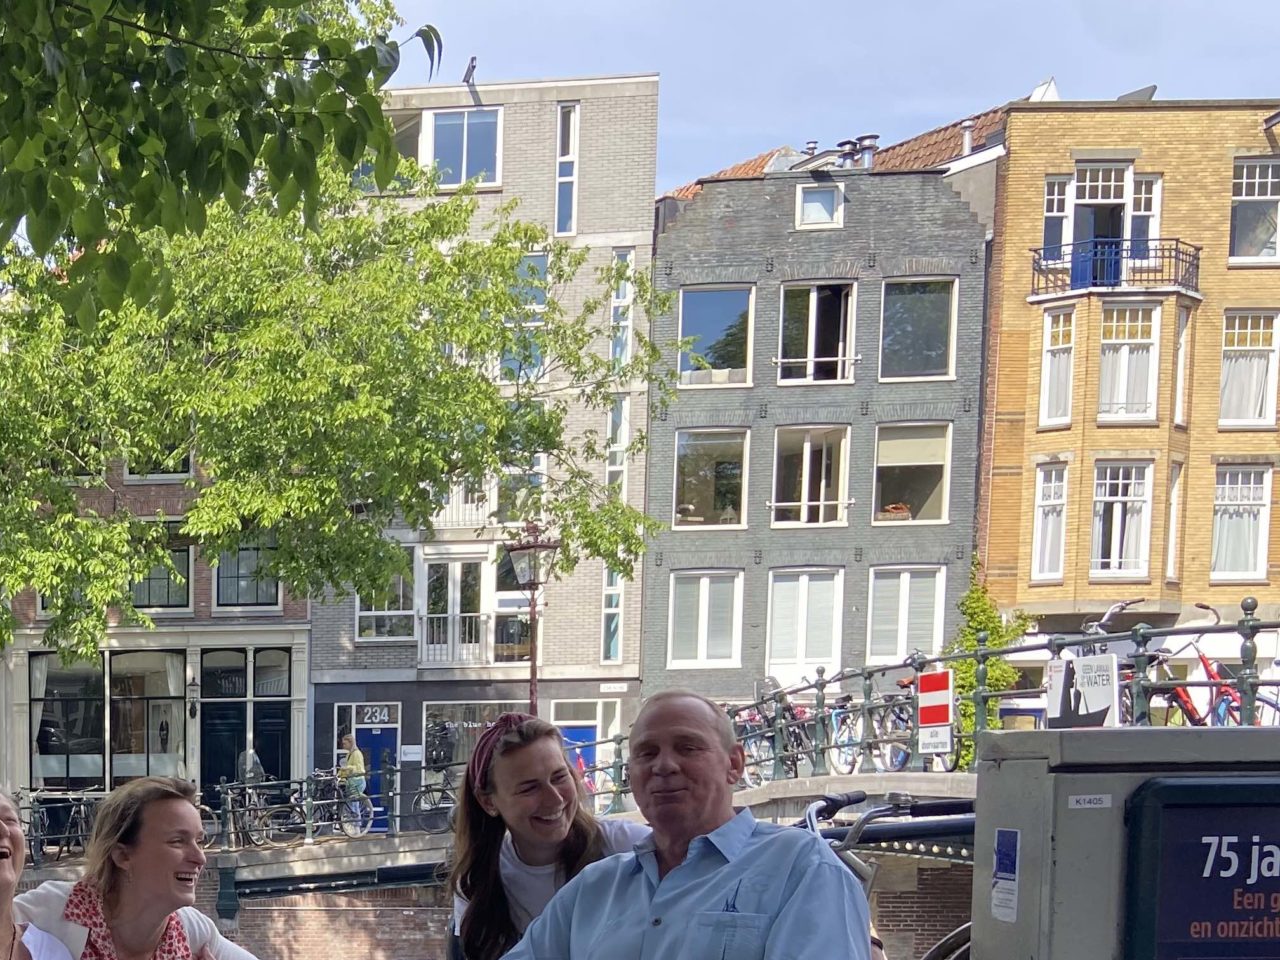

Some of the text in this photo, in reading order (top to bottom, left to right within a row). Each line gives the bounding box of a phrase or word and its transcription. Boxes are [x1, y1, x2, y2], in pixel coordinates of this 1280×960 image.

[1087, 674, 1111, 687] WATER
[364, 706, 389, 723] 234
[1075, 797, 1104, 806] K1405
[1201, 835, 1280, 884] 75 ja
[1233, 888, 1265, 909] Een
[1190, 921, 1212, 938] en
